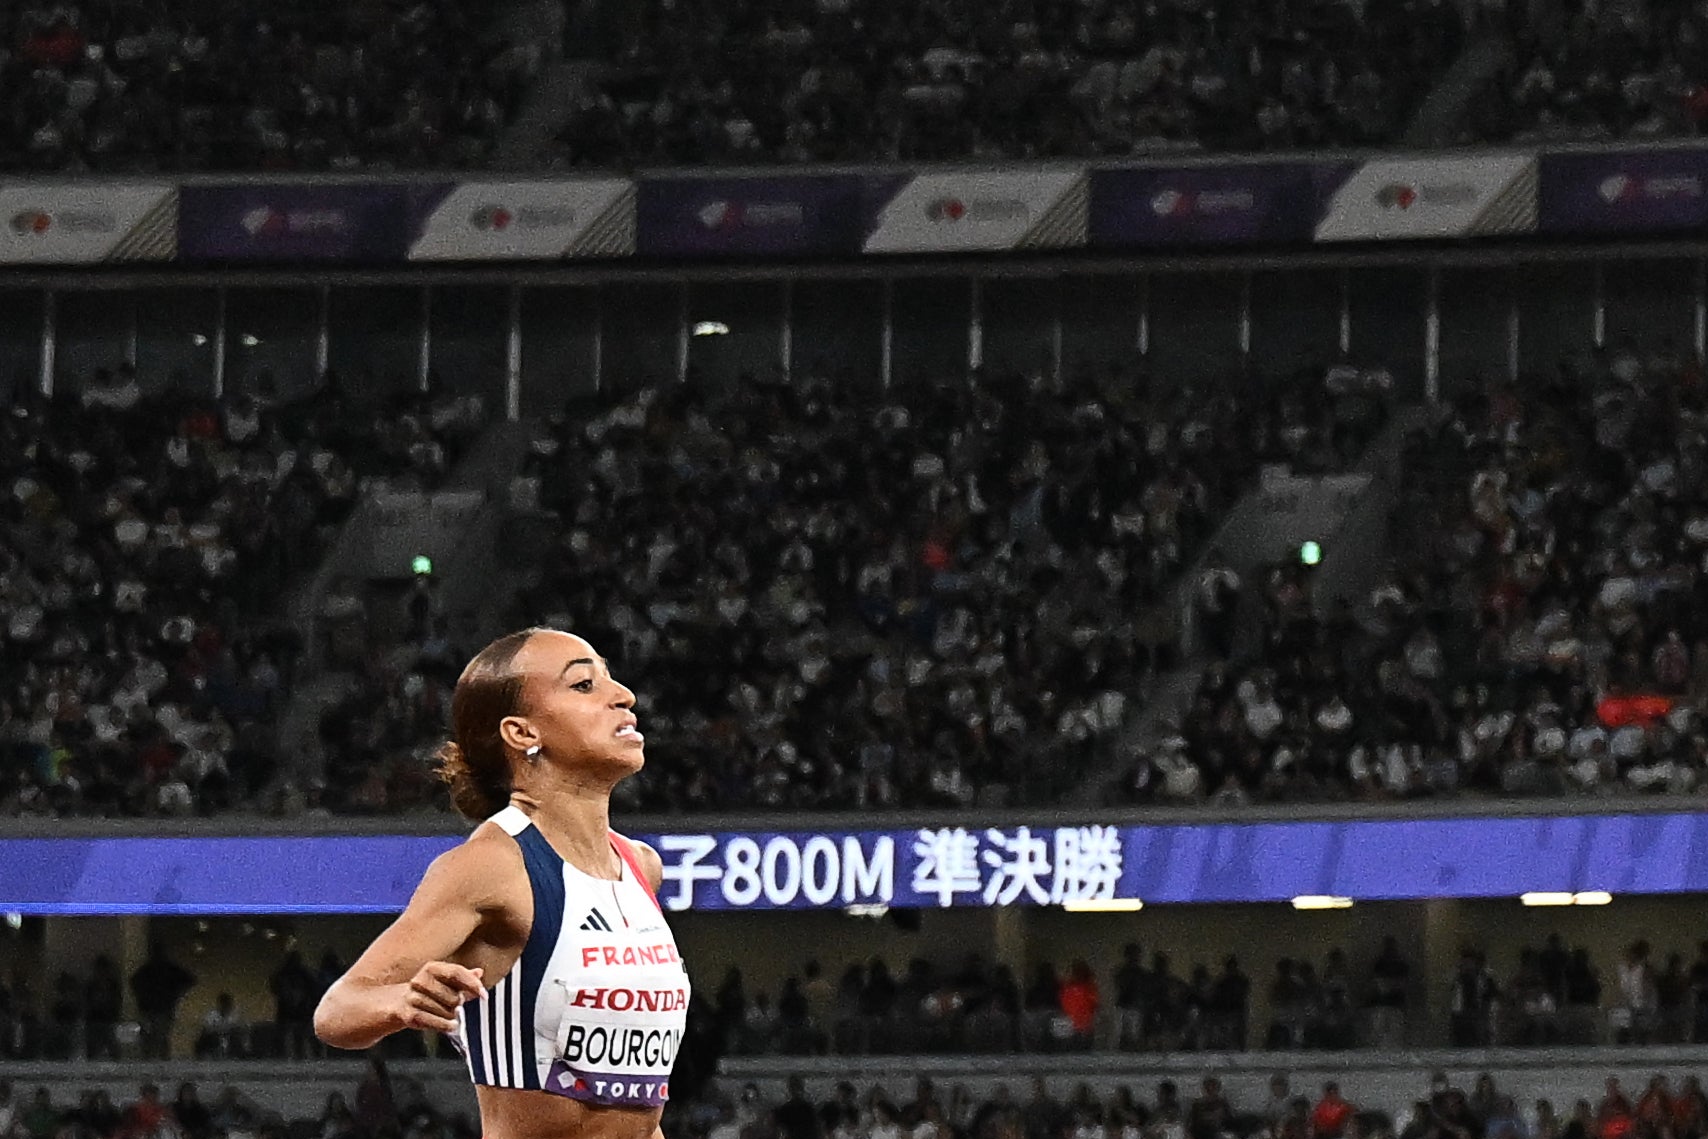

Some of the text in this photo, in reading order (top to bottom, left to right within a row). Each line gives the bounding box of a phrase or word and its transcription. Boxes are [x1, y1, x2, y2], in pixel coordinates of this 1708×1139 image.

[910, 825, 1123, 908] 準決勝
[570, 988, 686, 1012] HONDA
